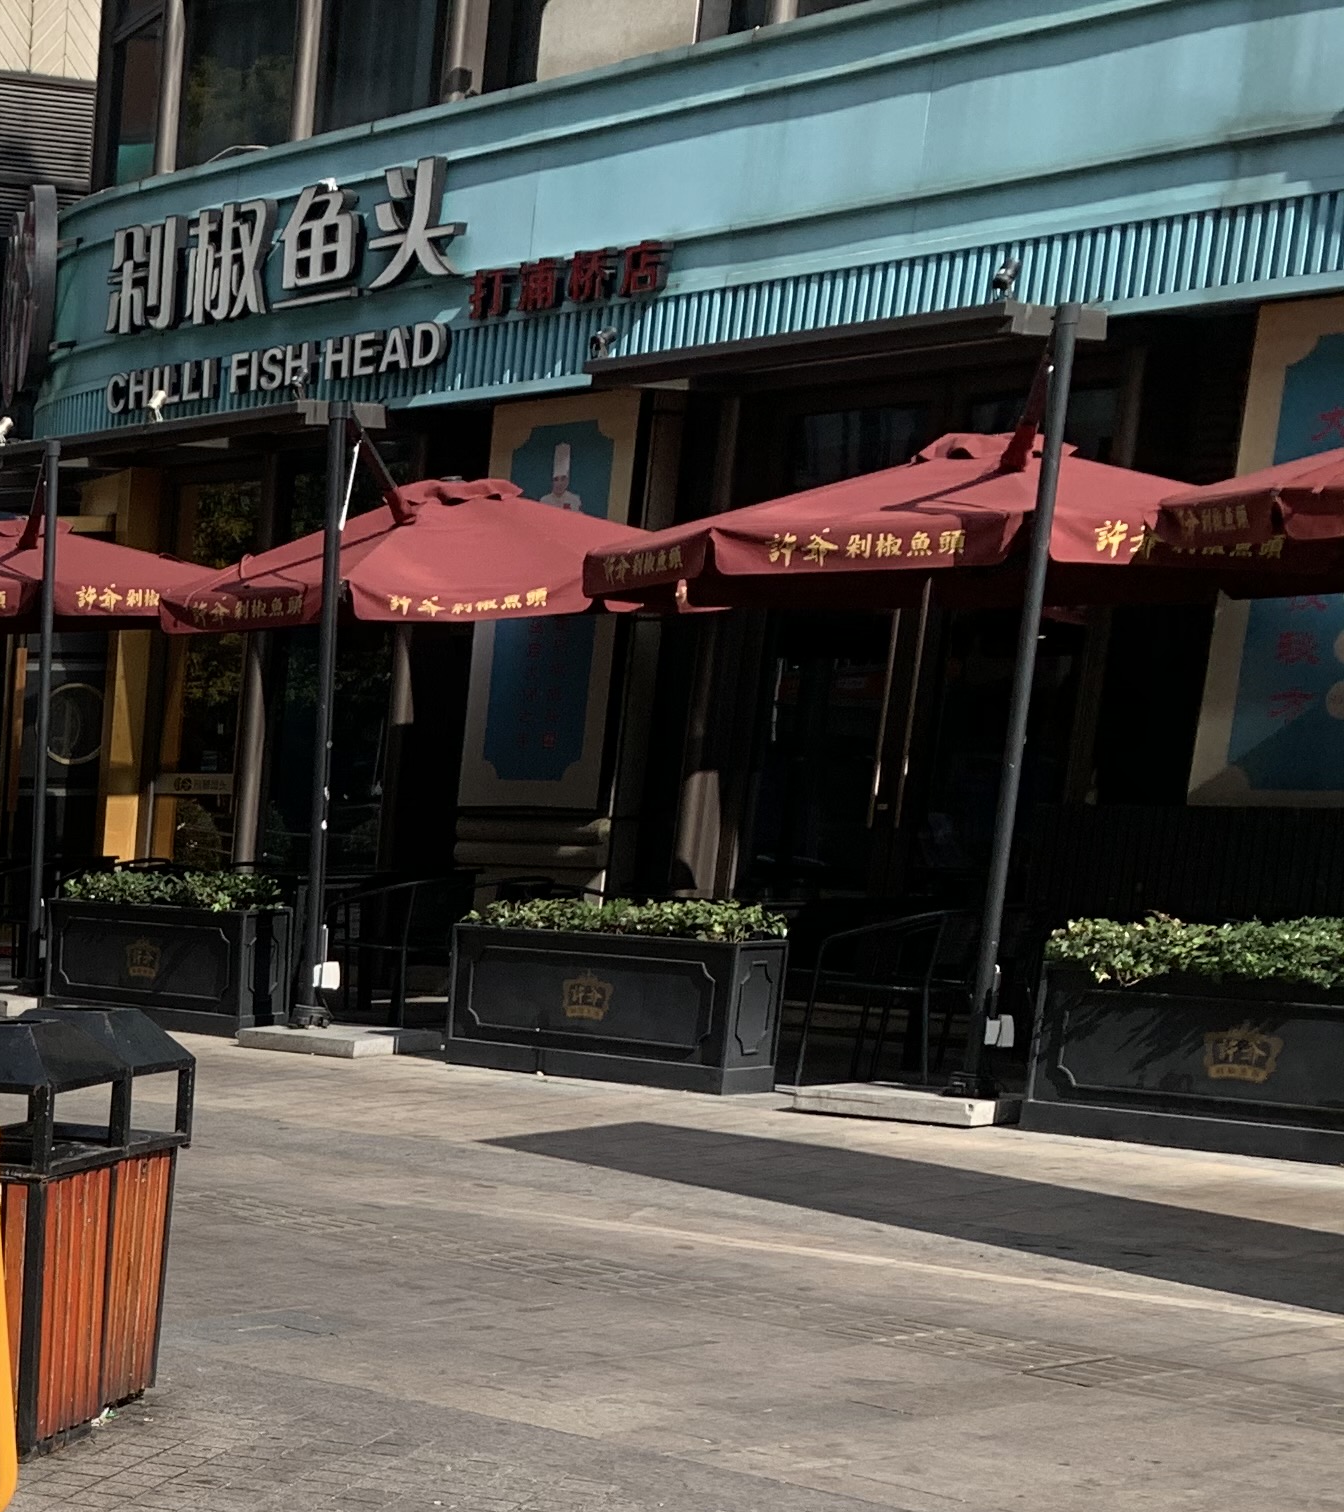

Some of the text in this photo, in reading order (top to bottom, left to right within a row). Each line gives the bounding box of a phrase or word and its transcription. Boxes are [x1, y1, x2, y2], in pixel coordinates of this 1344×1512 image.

[105, 156, 463, 334] 剁椒鱼头
[469, 240, 666, 320] 打浦桥店
[106, 321, 445, 414] CHILLI FISH HEAD
